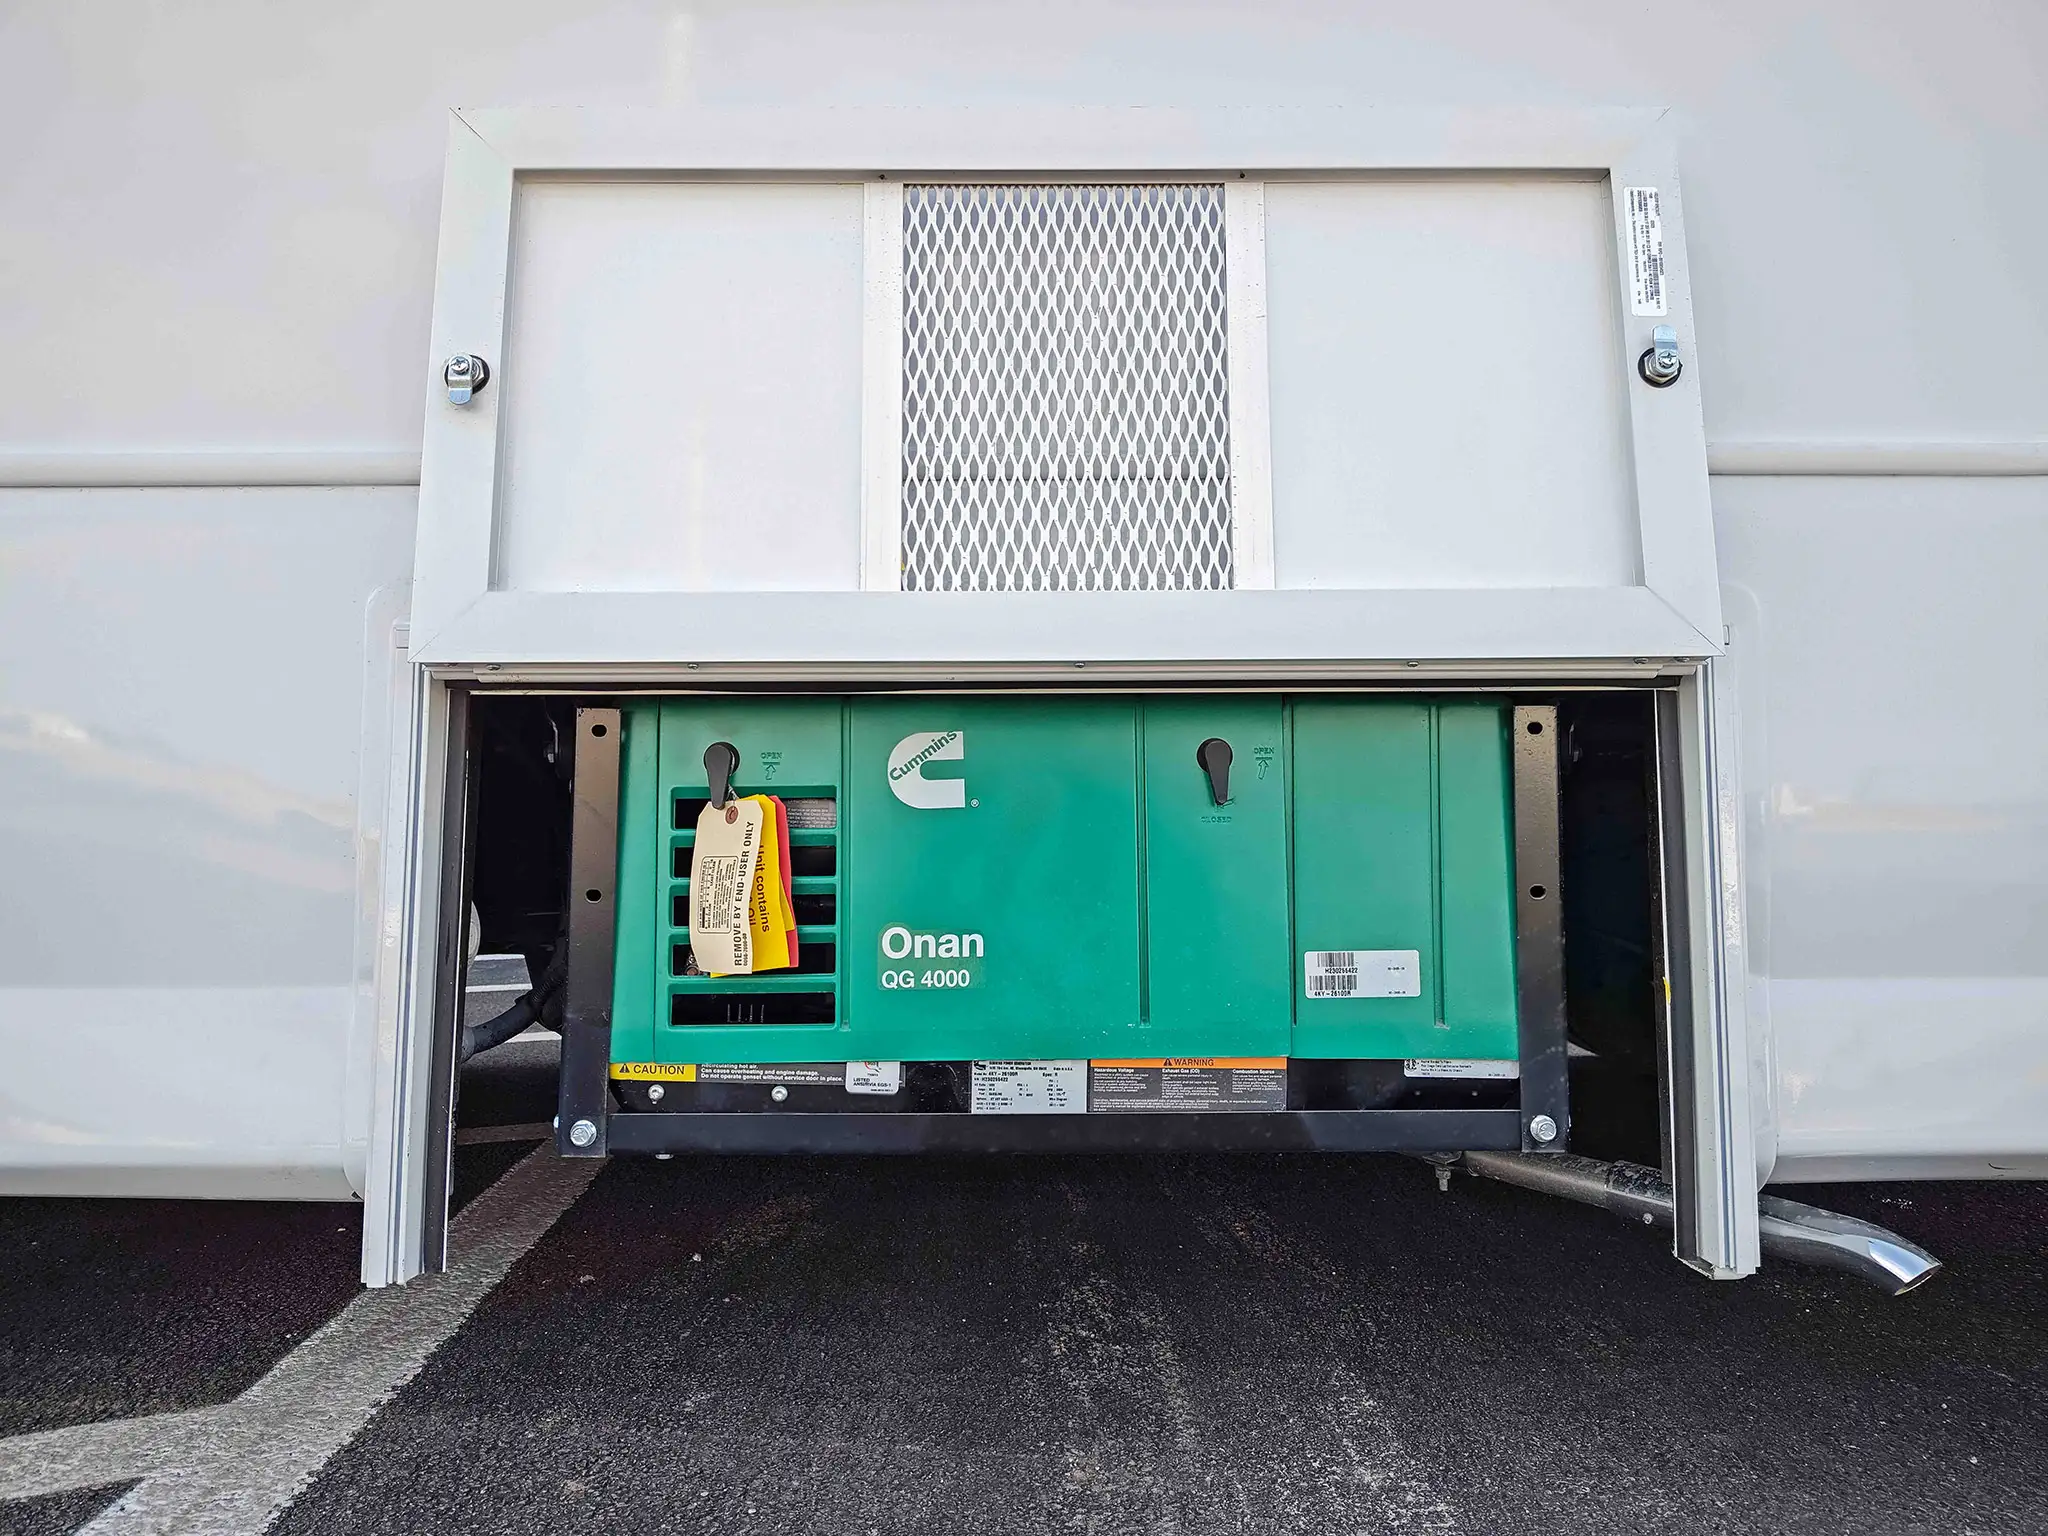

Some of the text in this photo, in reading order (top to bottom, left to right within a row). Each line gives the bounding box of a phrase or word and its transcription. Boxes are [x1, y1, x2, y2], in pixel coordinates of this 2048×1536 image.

[889, 730, 958, 781] Cummins
[733, 821, 754, 966] REMOVE BY END-USER ONLY
[756, 875, 770, 933] contains
[881, 926, 984, 959] Onan
[881, 969, 970, 989] QG 4000
[633, 1064, 685, 1075] CAUTION
[1173, 1058, 1214, 1067] WARNING
